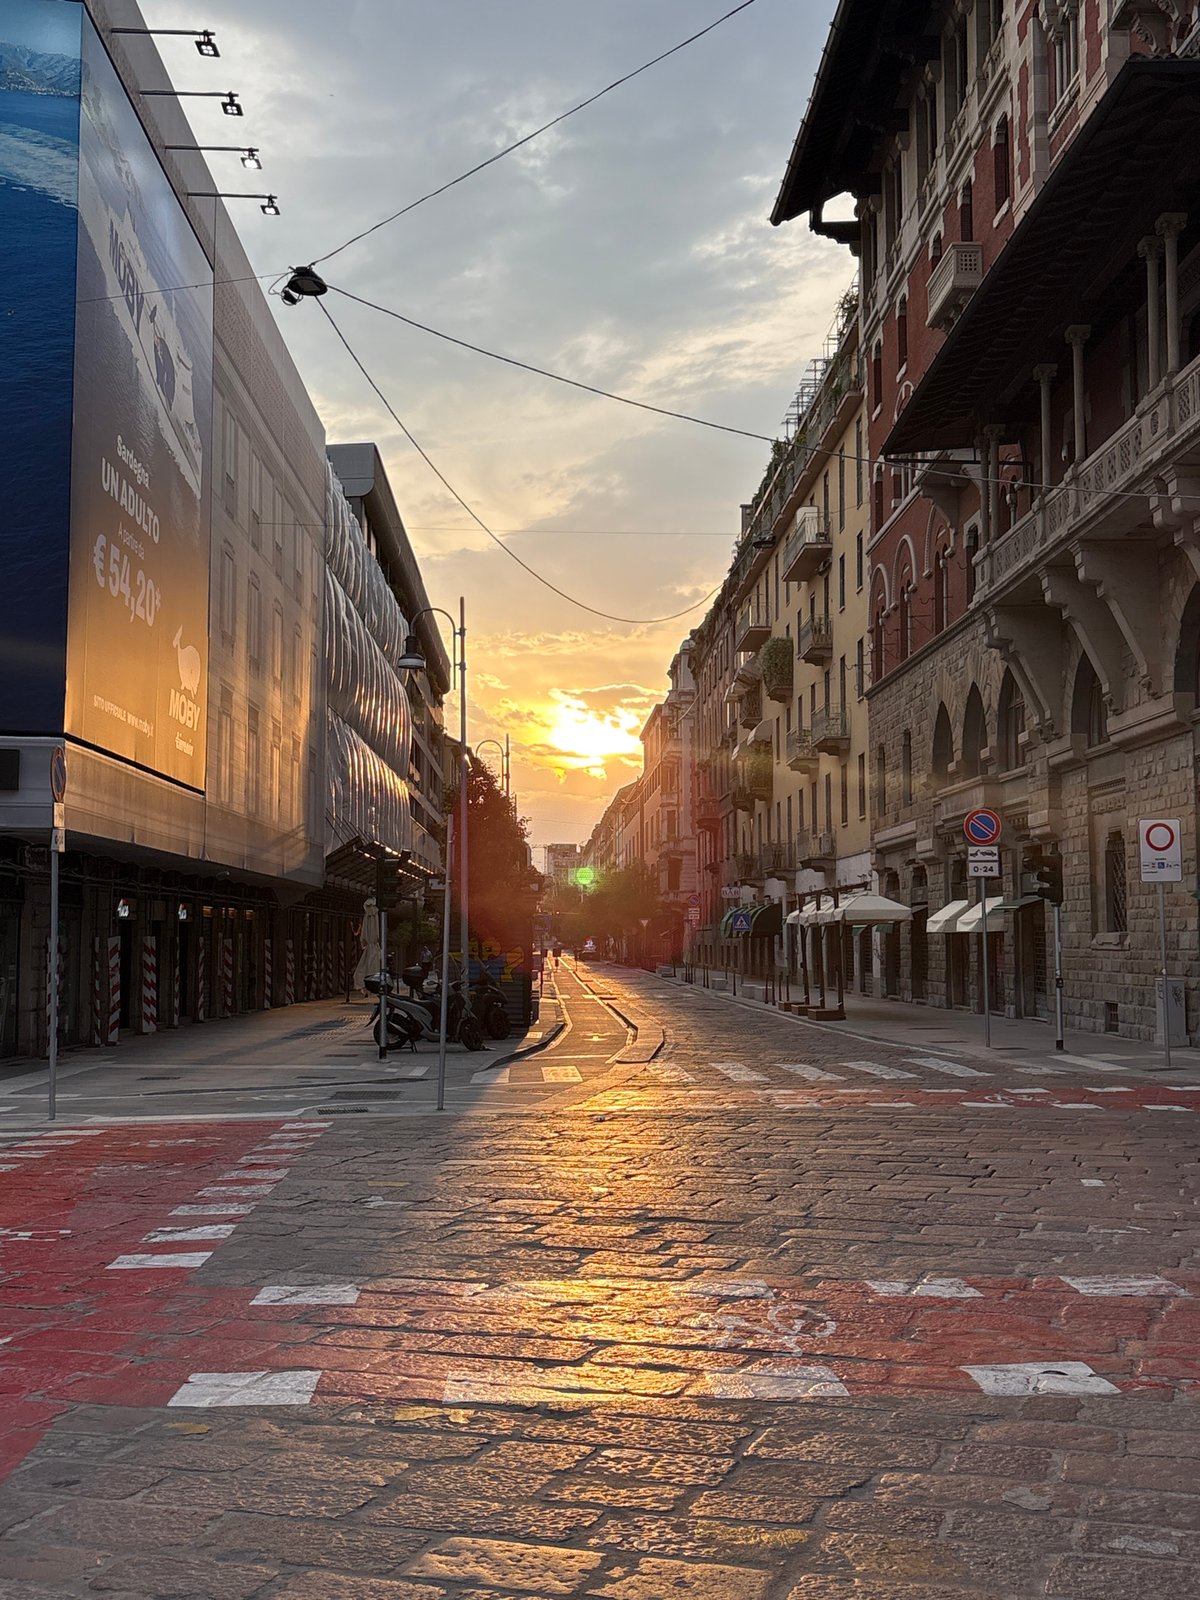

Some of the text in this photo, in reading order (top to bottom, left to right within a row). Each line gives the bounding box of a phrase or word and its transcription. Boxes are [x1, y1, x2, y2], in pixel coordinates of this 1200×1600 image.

[109, 218, 145, 337] MOBY
[116, 434, 150, 490] Sardegna
[101, 456, 160, 544] UN ADULTO
[168, 688, 201, 732] MOBY
[972, 865, 994, 873] 0-24
